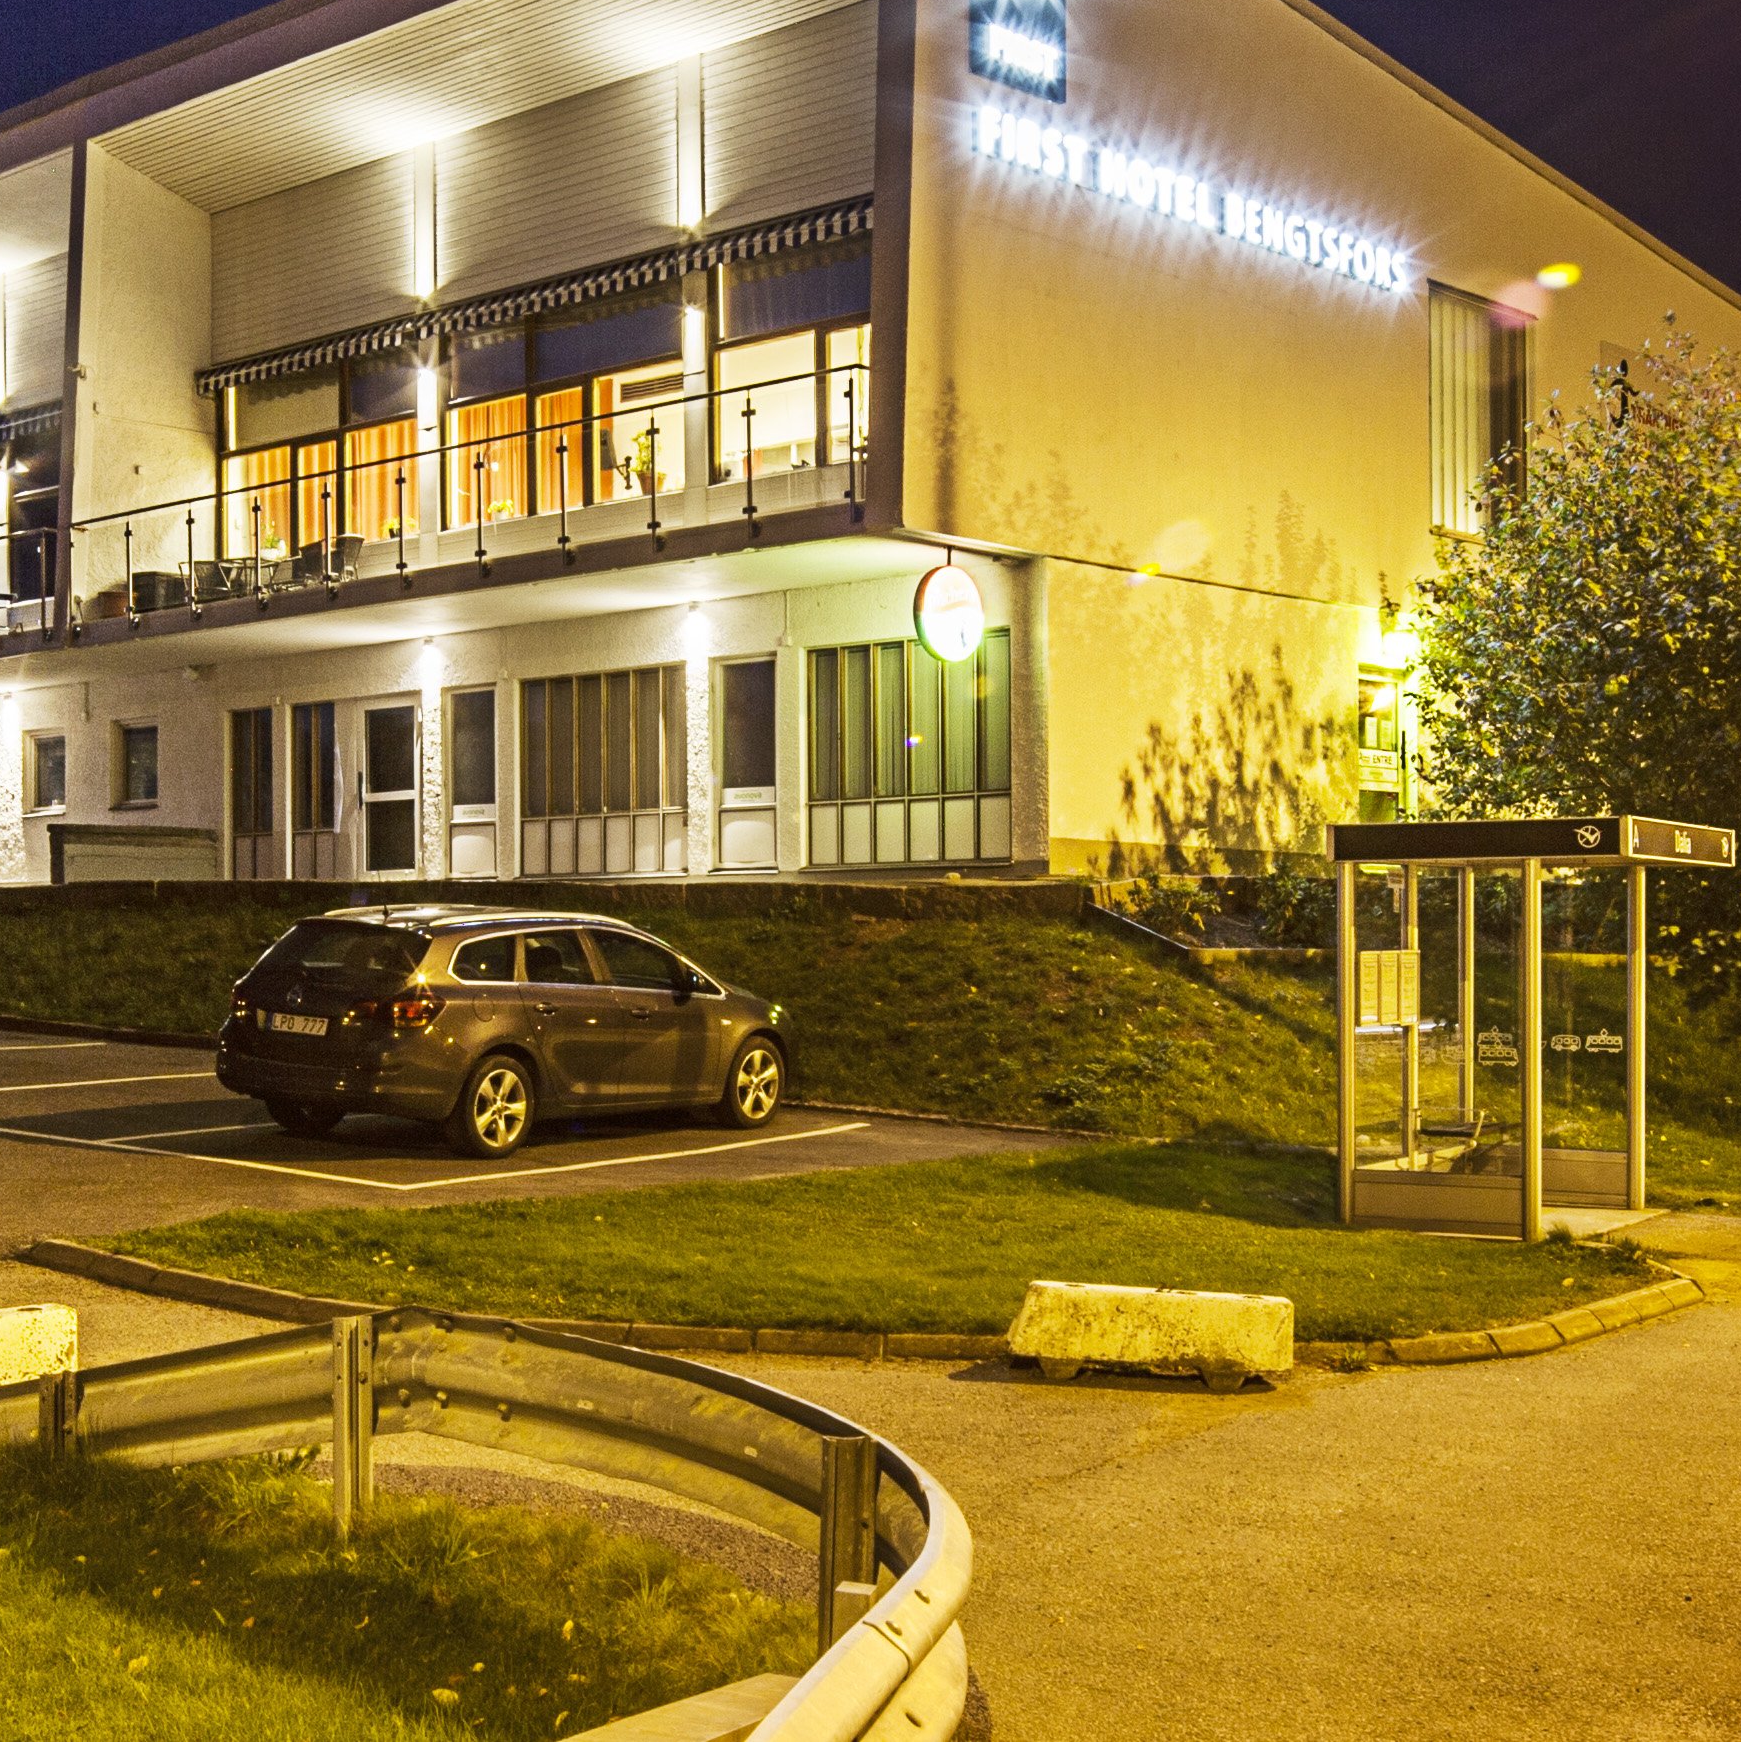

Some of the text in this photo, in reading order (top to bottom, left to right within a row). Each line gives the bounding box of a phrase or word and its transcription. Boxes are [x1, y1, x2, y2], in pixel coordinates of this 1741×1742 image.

[978, 105, 1408, 294] FIRST HOTEL BENGTSFORS
[301, 1017, 326, 1034] 777
